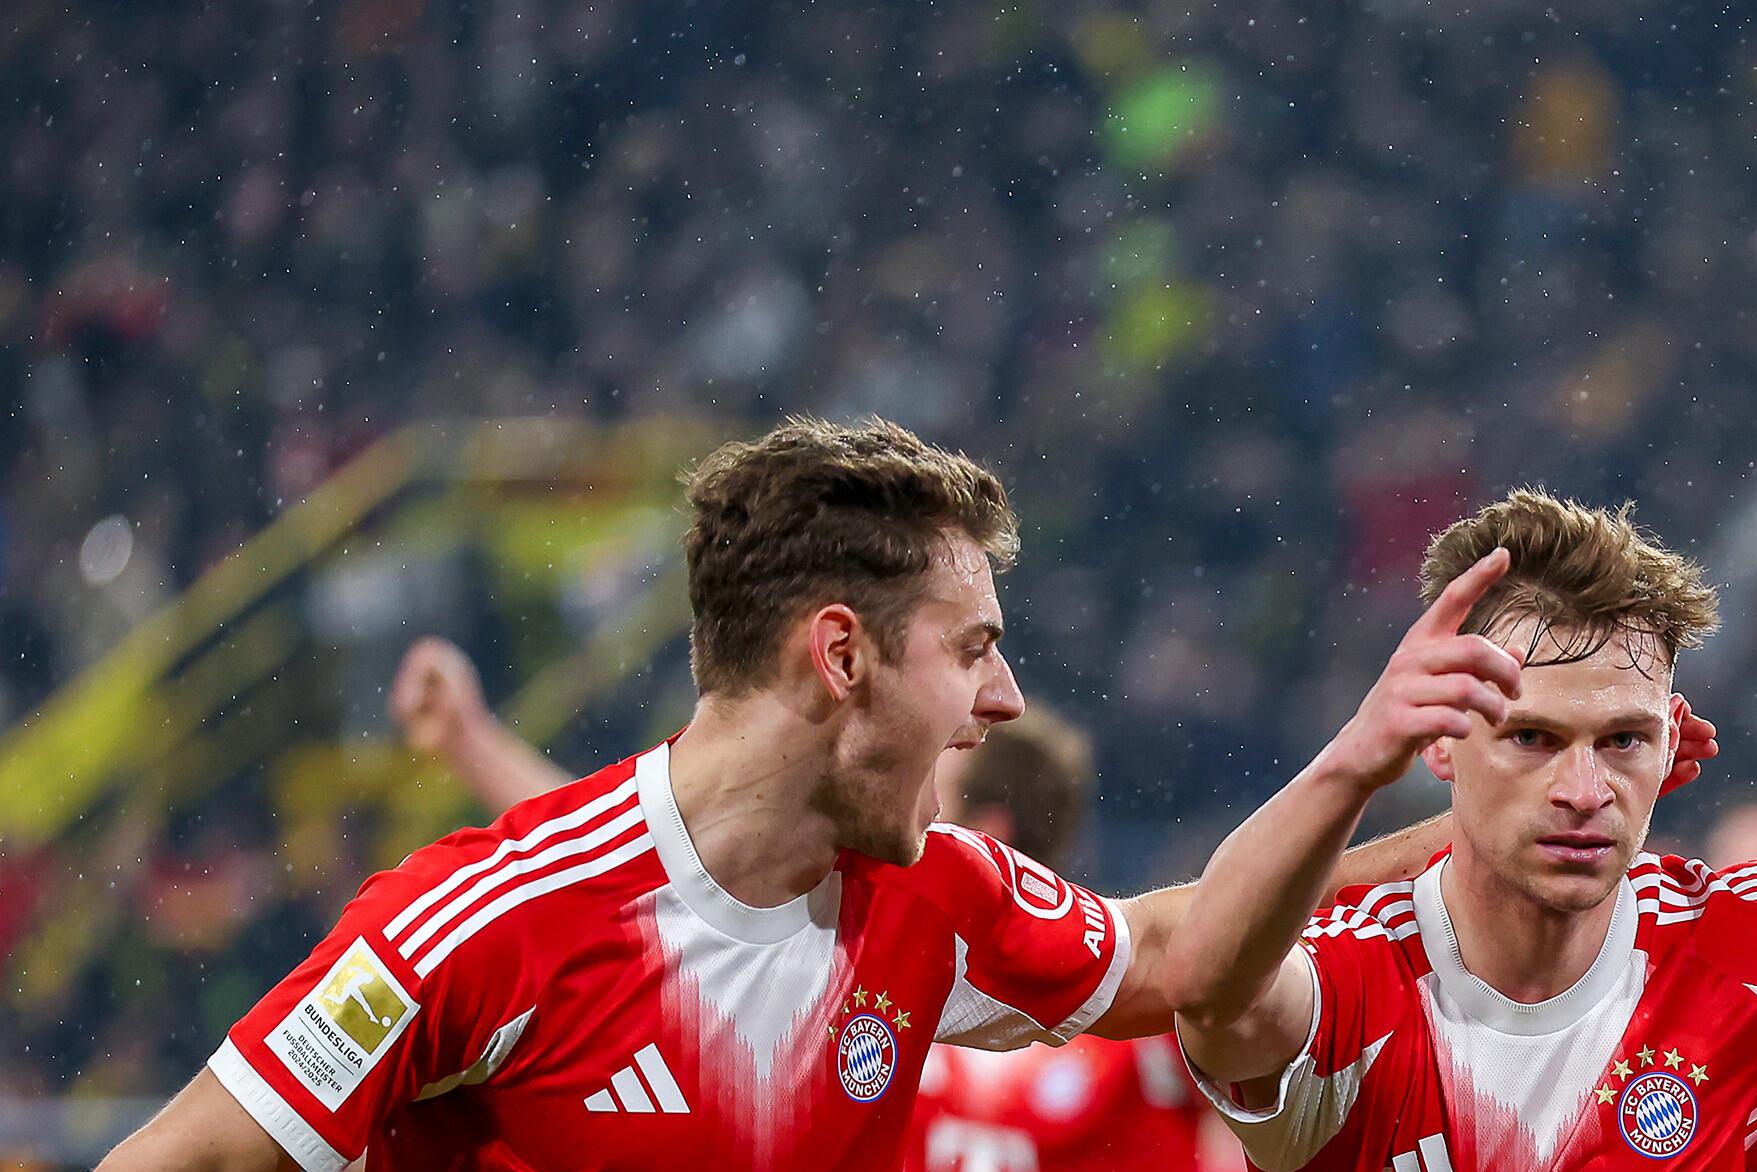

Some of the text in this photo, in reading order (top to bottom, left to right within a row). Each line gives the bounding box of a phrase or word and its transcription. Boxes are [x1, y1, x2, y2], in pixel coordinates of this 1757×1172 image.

[298, 1034, 337, 1076] DEUTSCHER
[304, 1003, 365, 1069] BUNDESLIGA
[840, 1020, 890, 1055] FC BAYERN
[282, 1029, 343, 1093] FUSSBALLMEISTER
[287, 1049, 323, 1087] 2024/2025
[1624, 1078, 1689, 1115] FC BAYERN
[1629, 1117, 1693, 1153] MÜNCHEN
